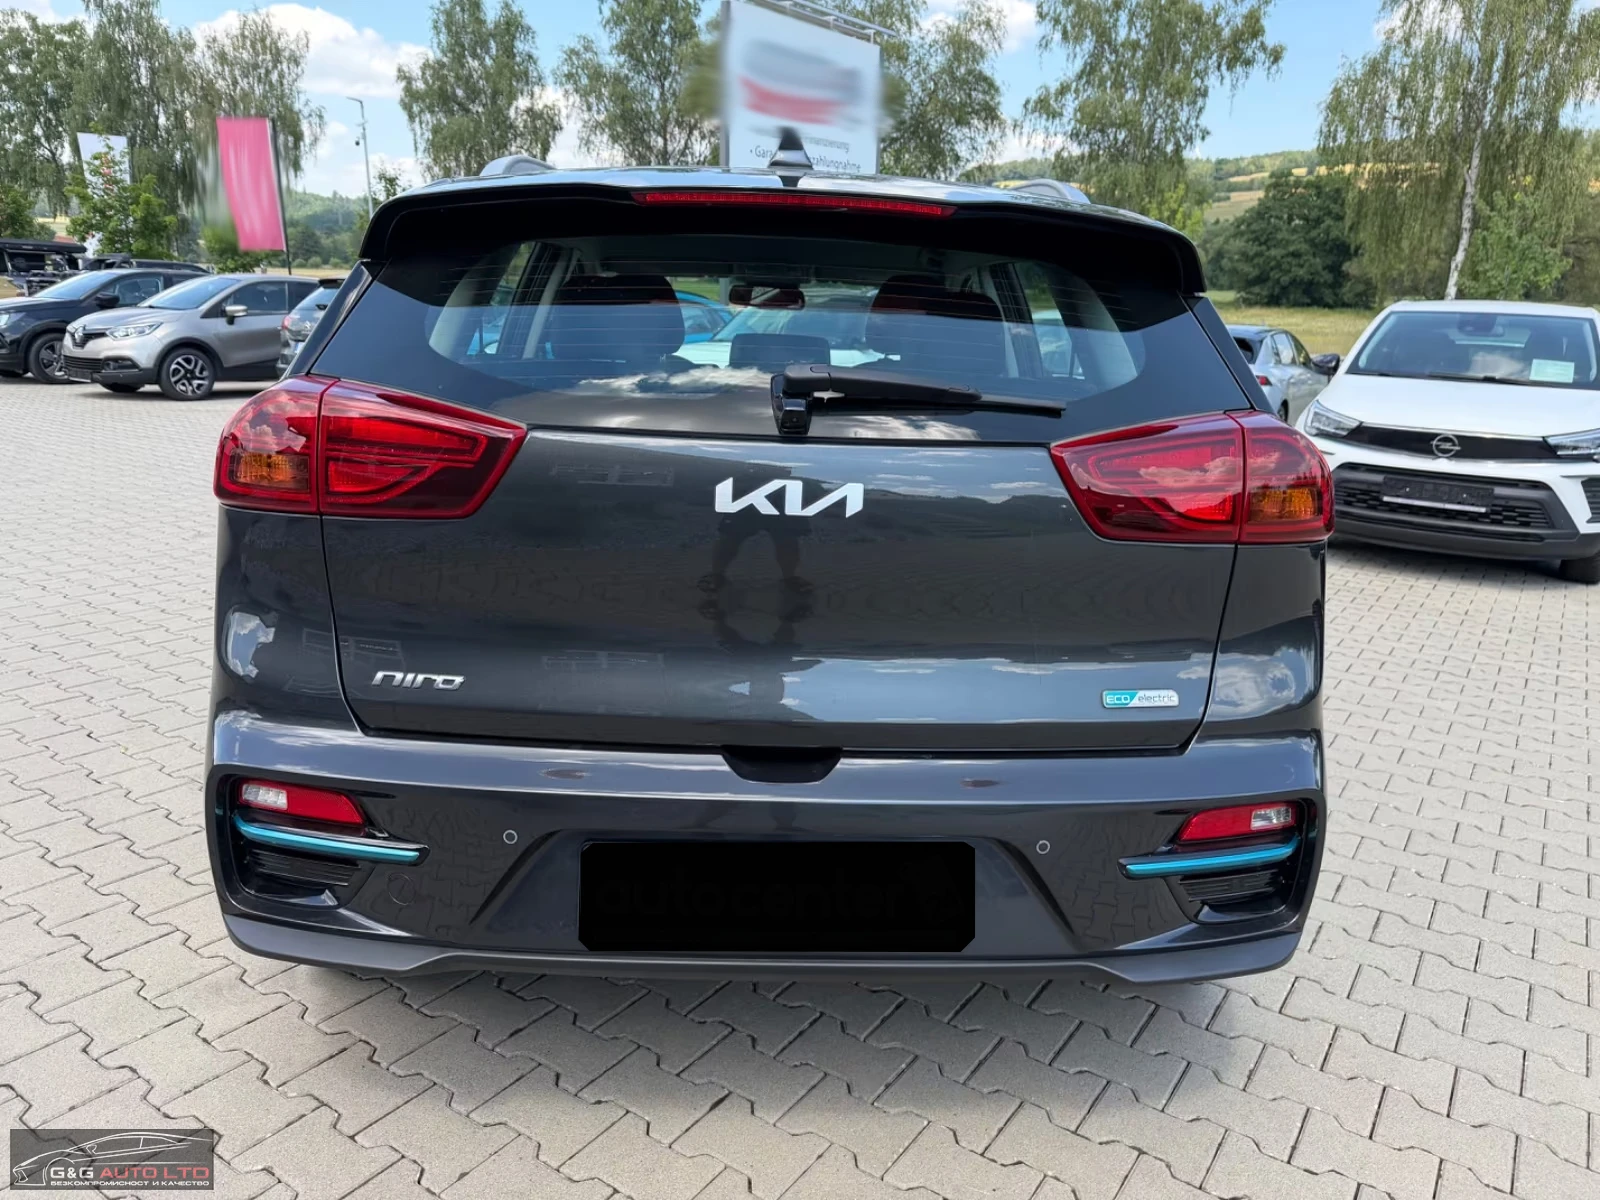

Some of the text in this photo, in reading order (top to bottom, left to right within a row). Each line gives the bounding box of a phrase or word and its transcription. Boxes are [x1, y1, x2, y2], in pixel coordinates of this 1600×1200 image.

[755, 145, 774, 159] Gara
[715, 477, 865, 518] KIA
[1106, 692, 1176, 704] ECO electric
